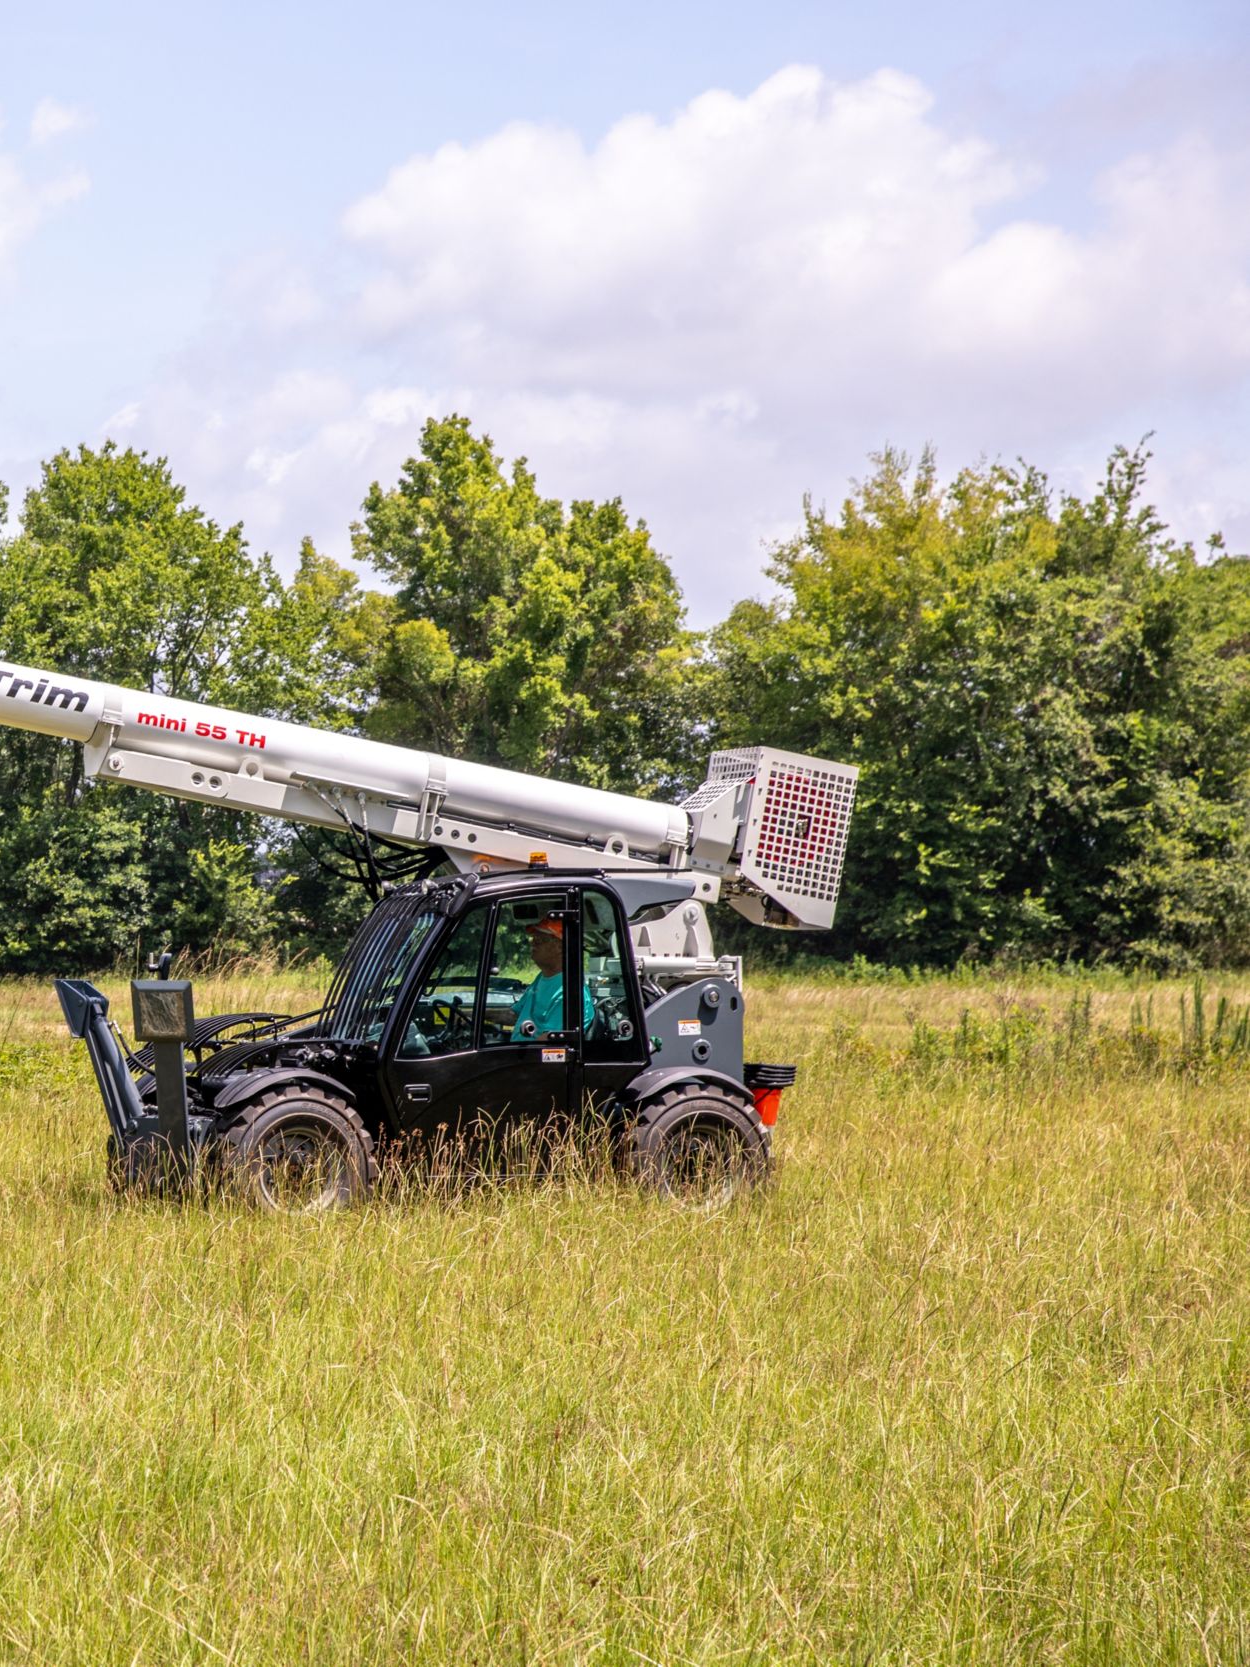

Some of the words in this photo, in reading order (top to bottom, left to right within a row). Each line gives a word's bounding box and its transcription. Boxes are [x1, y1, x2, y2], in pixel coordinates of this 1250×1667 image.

[137, 712, 187, 733] mini
[194, 721, 228, 741] 55
[235, 729, 267, 749] TH
